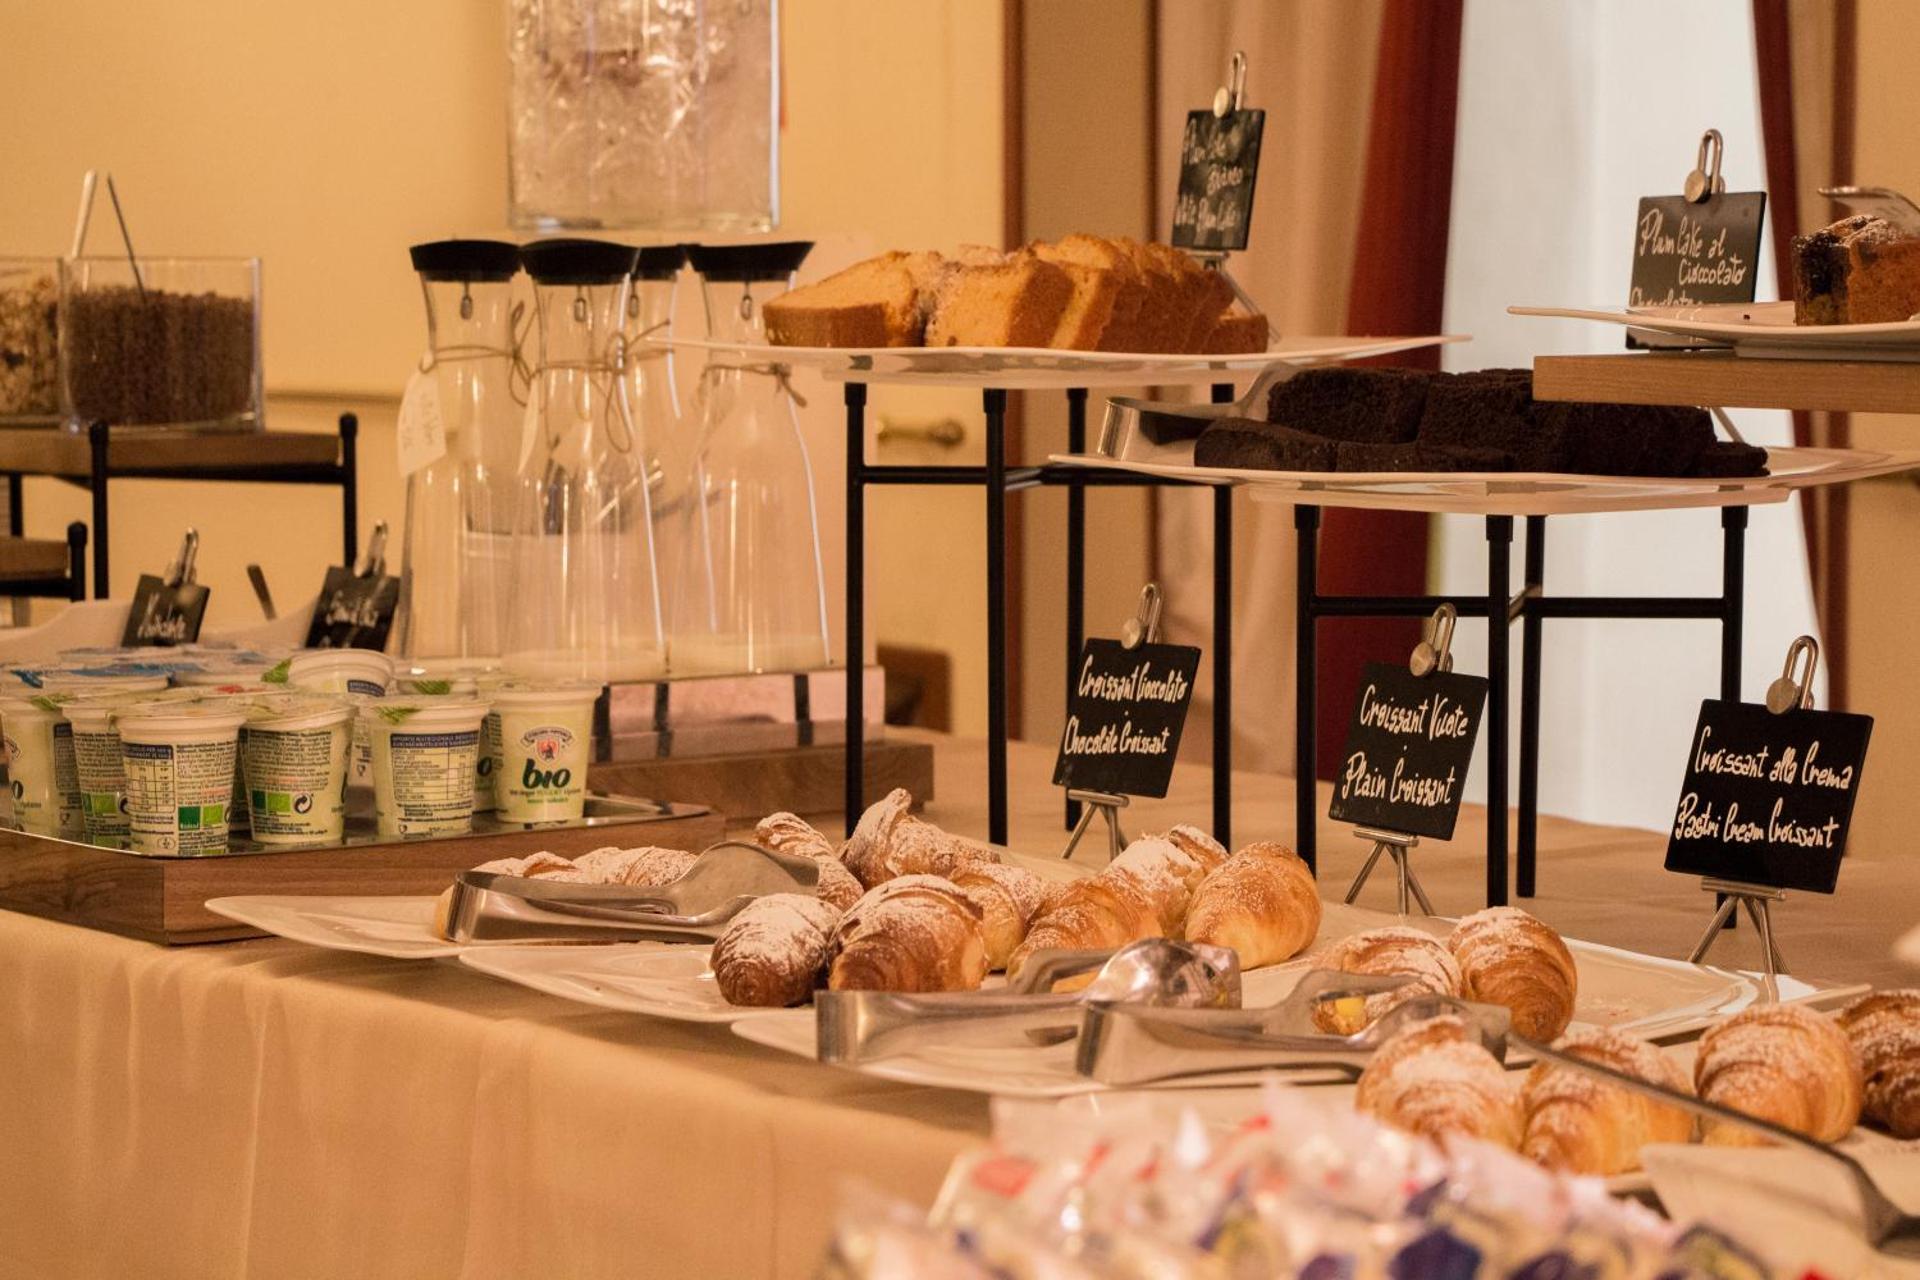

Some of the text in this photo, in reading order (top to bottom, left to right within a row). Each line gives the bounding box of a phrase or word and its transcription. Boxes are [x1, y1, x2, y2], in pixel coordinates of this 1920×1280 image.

[1640, 208, 1675, 257] Plum
[1677, 215, 1703, 258] Cake
[1678, 252, 1747, 285] Cioccolato
[1078, 654, 1188, 703] Croissant Cioccolato
[1360, 684, 1428, 734] Croissant
[1064, 715, 1170, 755] Chocolate Croissant
[1695, 725, 1853, 789] Croissant alla Crema
[522, 758, 571, 789] bio
[1342, 751, 1456, 807] Plain Croissant
[1675, 792, 1840, 848] Pastri Cream Croissant
